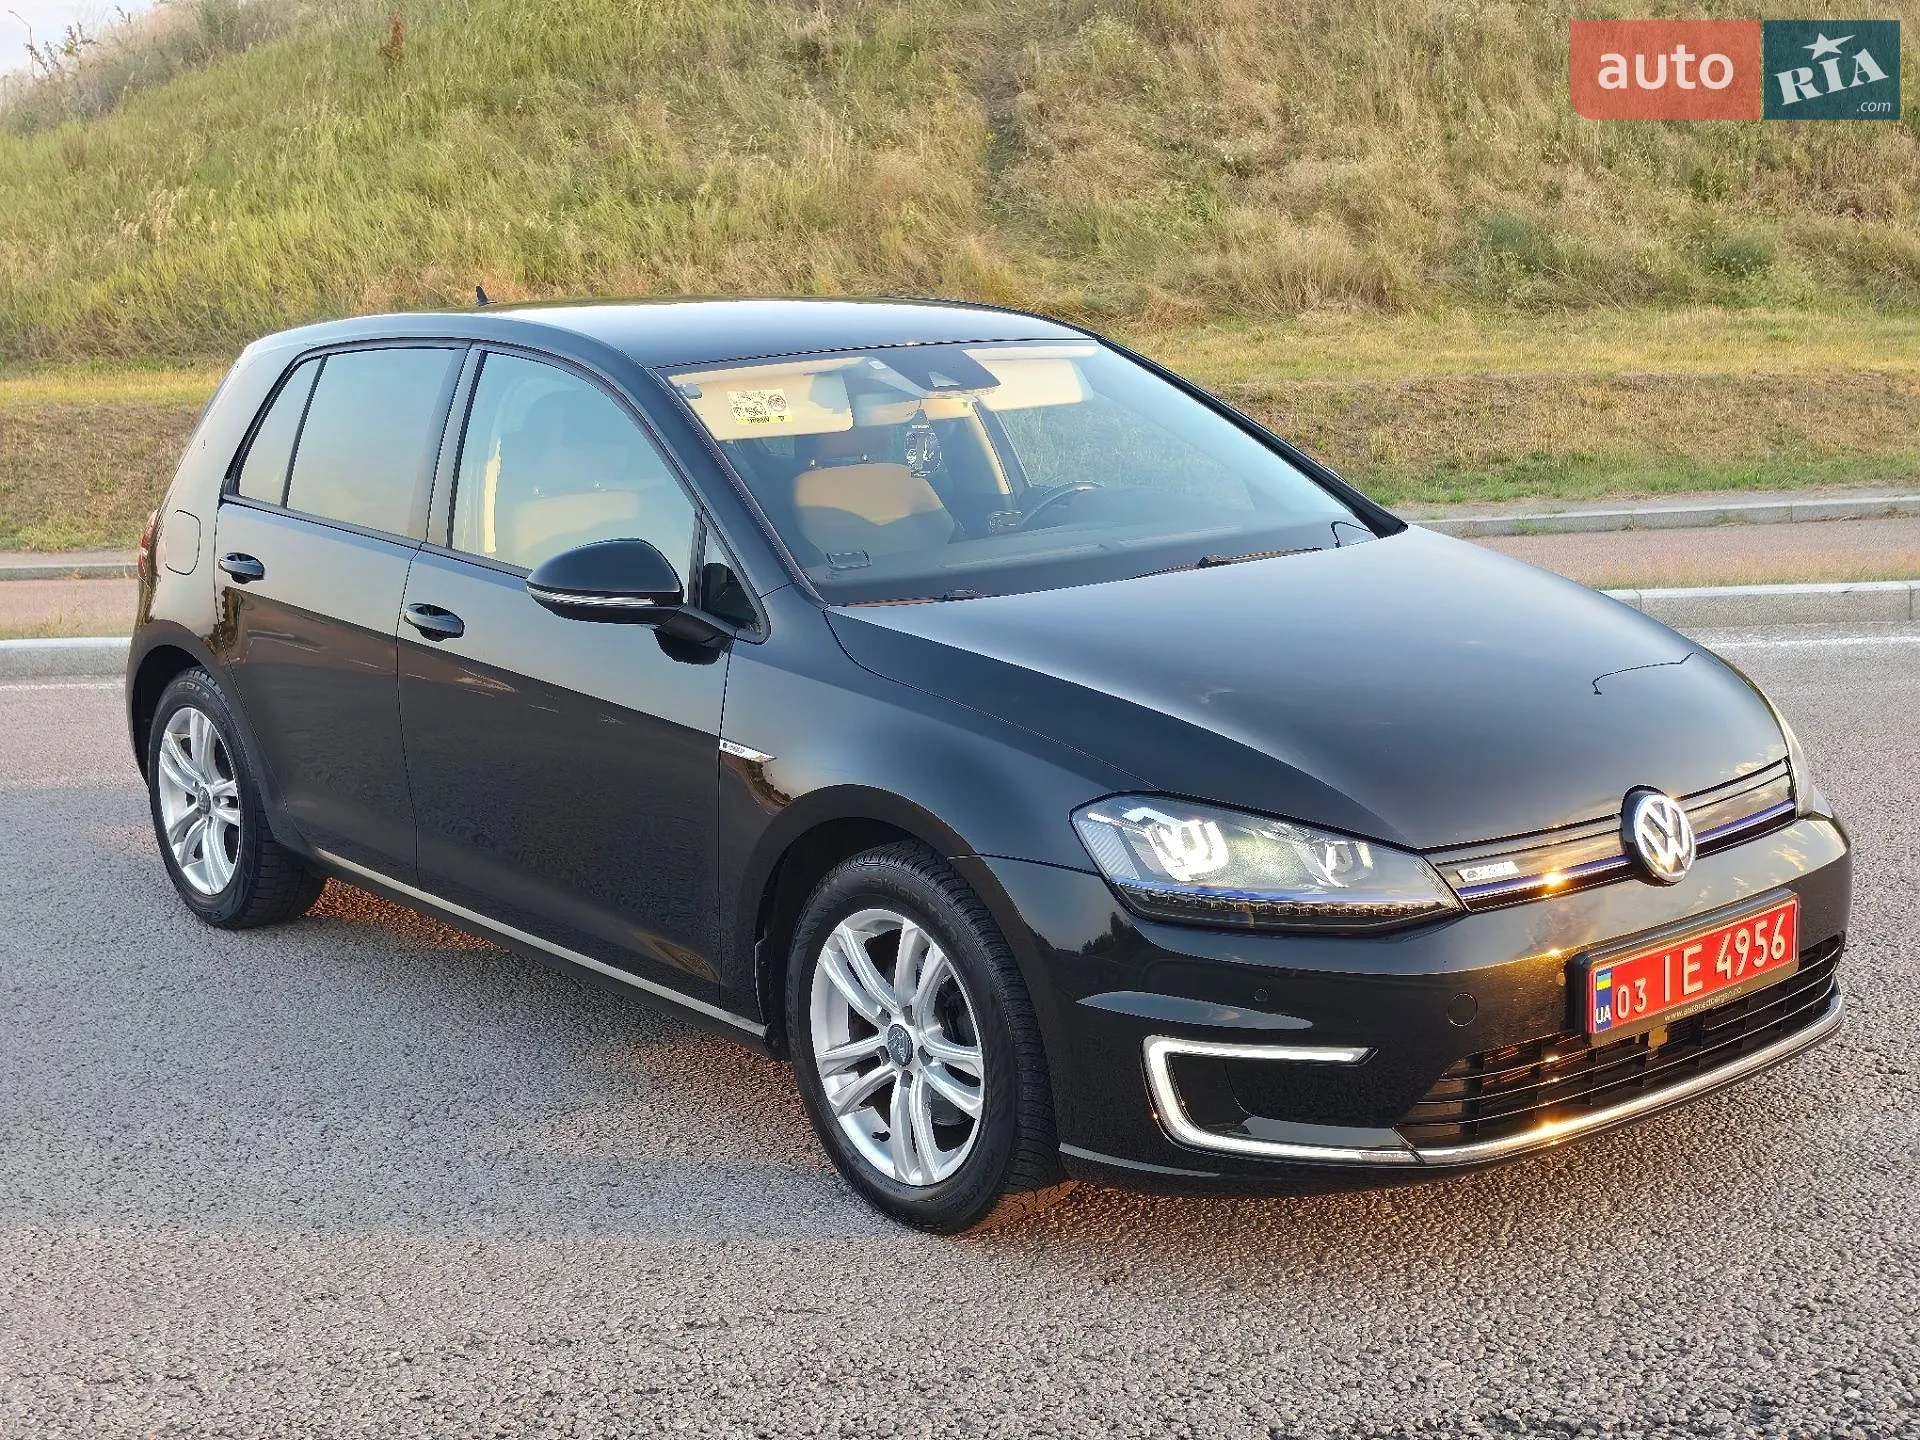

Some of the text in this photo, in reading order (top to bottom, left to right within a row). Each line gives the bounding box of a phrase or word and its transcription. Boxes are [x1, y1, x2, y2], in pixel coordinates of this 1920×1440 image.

[1616, 913, 1785, 1019] 03 IE 4956
[1595, 1005, 1612, 1025] UA
